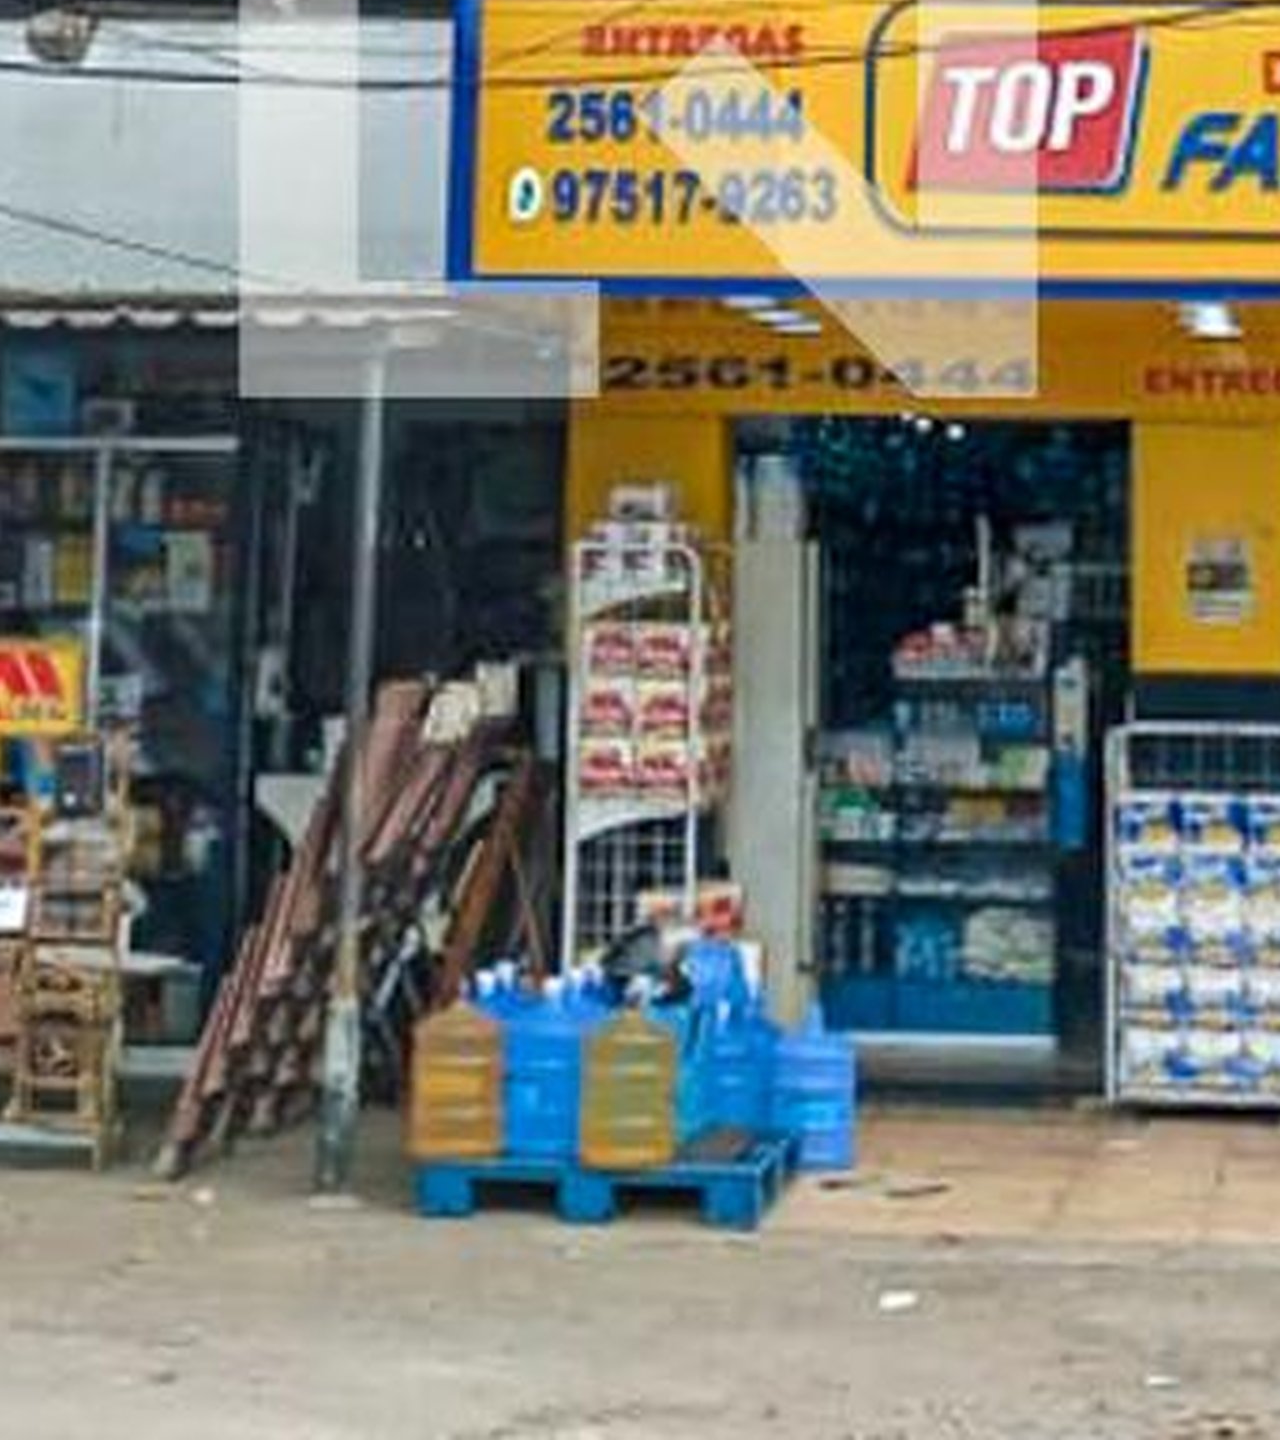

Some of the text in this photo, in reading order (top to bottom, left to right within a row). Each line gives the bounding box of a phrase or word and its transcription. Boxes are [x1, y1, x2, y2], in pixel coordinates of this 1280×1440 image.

[581, 23, 805, 56] ENTREGAS
[547, 89, 804, 142] 2561-0444
[942, 60, 1116, 154] TOP
[552, 168, 838, 224] 97517-9263
